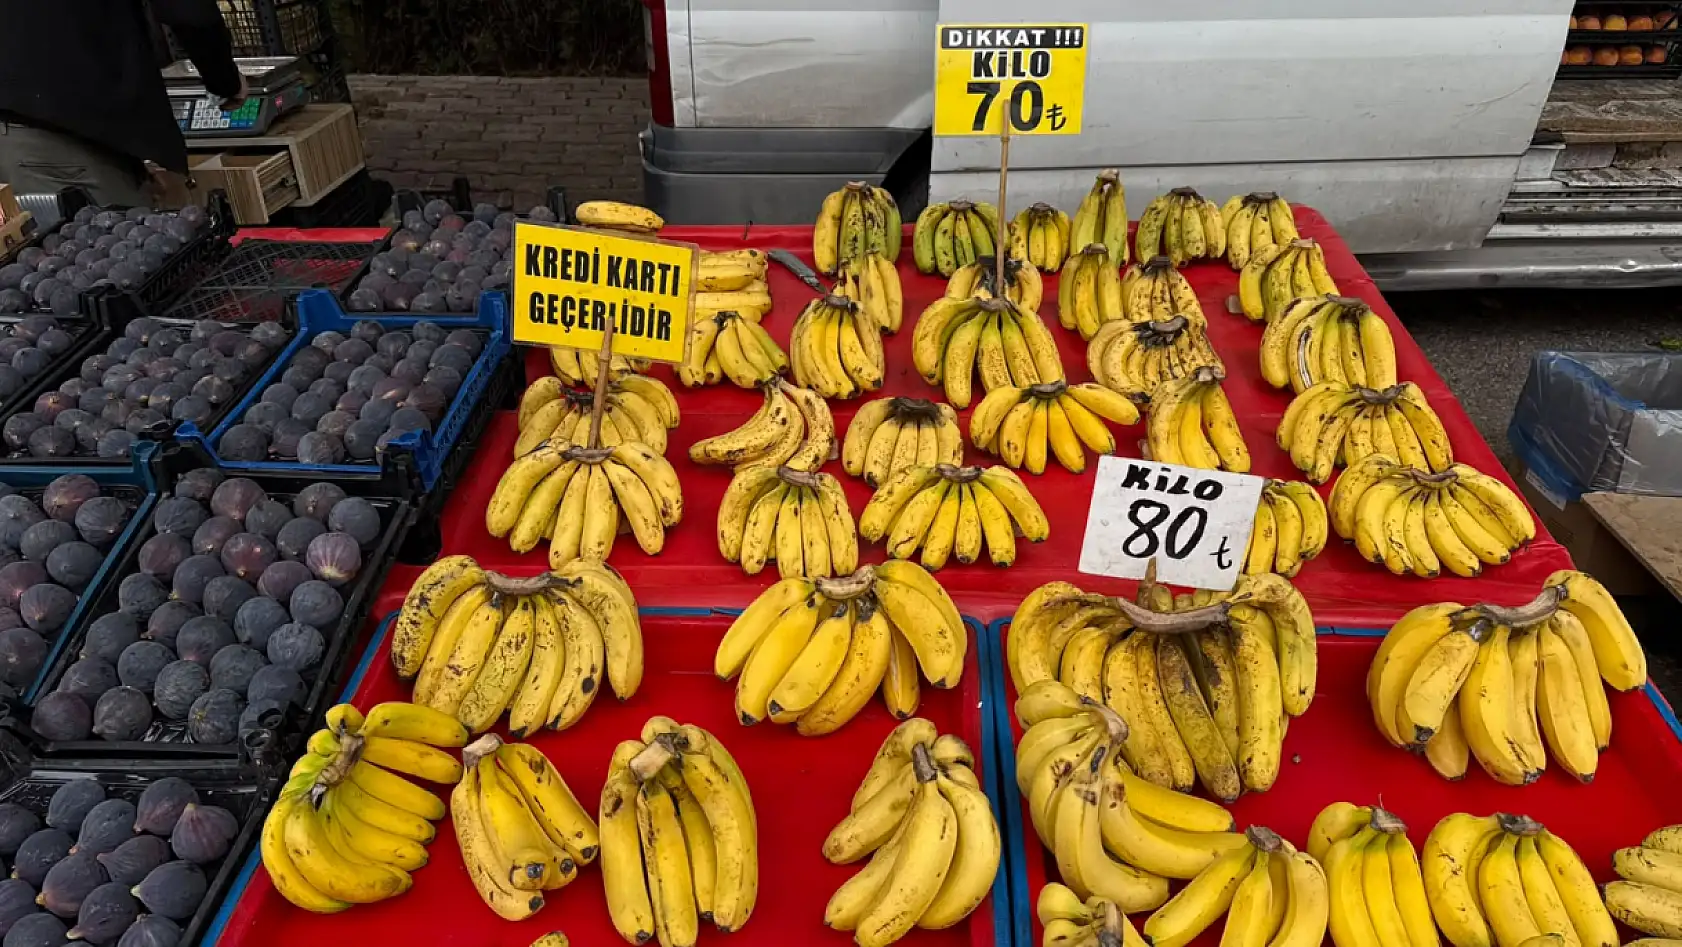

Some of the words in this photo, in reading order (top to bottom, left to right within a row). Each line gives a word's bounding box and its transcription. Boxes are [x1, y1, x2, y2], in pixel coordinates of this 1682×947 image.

[1054, 29, 1081, 46] !!!
[525, 243, 600, 285] KREDİ
[607, 254, 681, 297] KARTI
[529, 290, 672, 342] GEÇERLİDİR
[1122, 498, 1208, 560] 80
